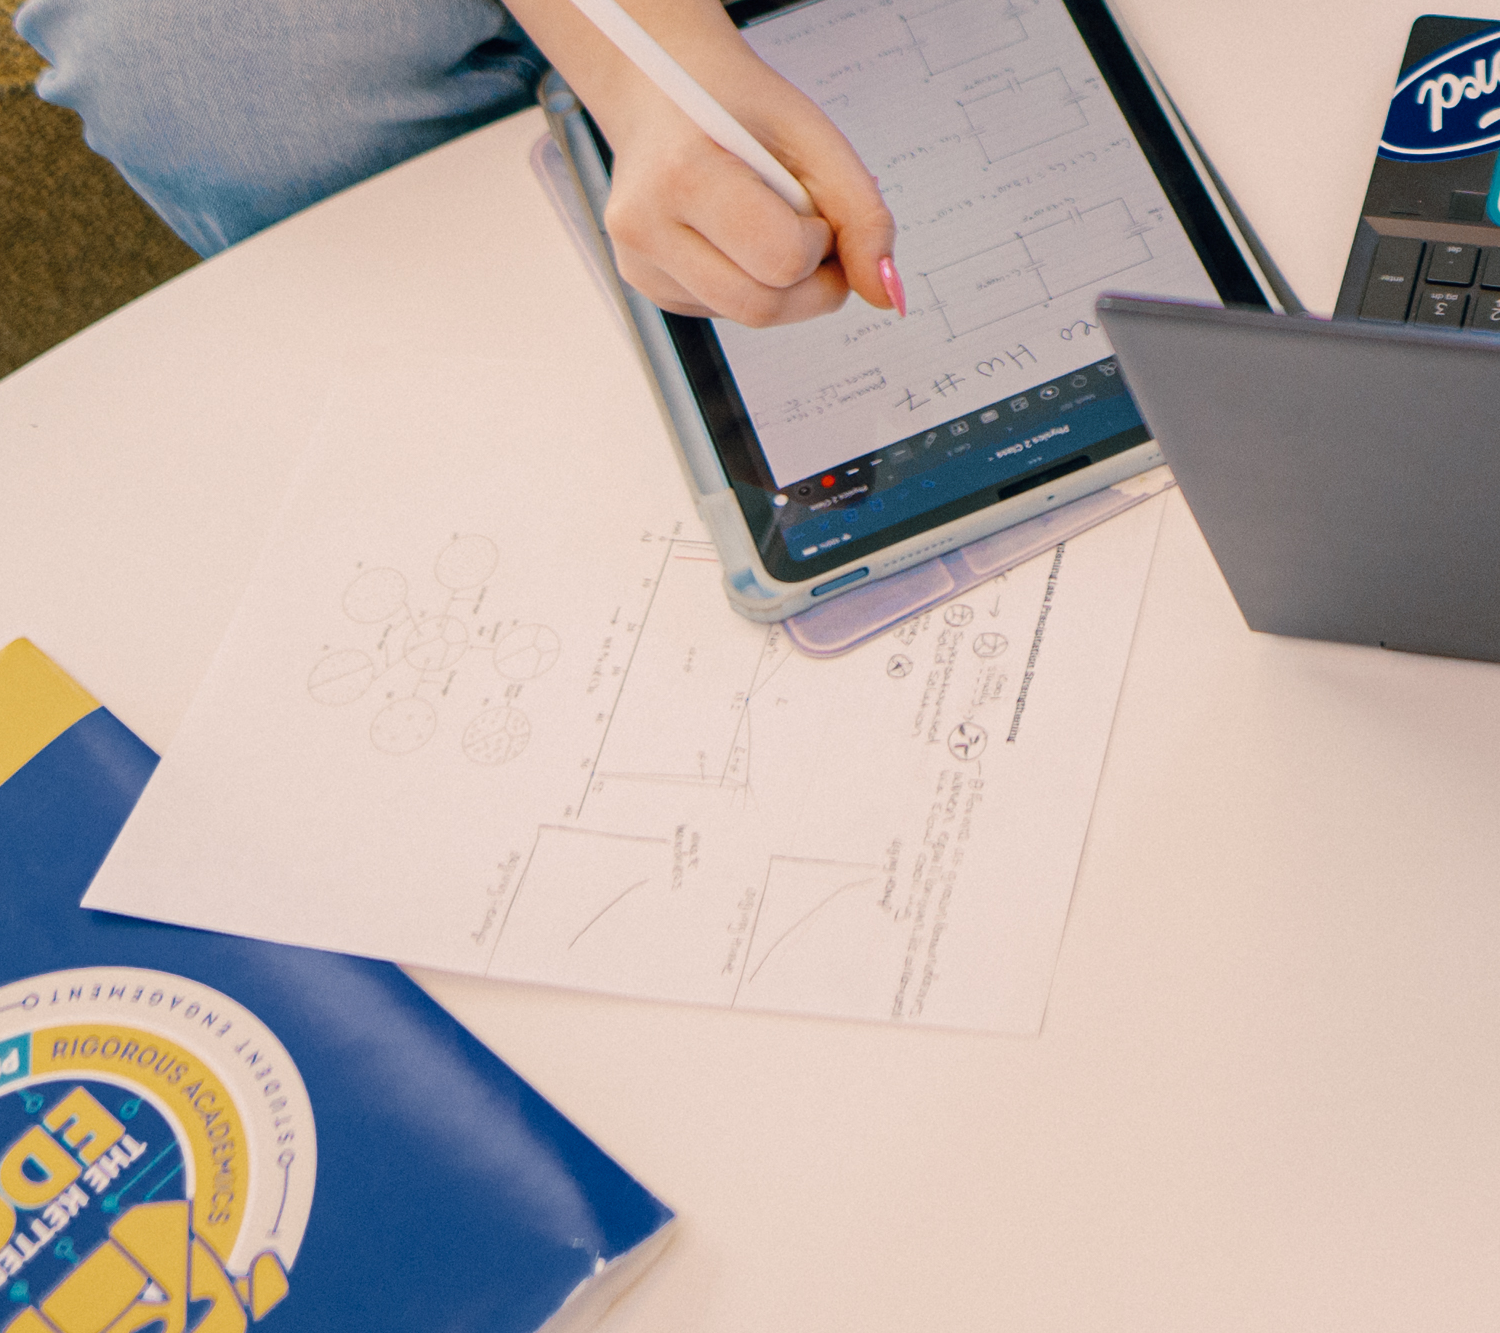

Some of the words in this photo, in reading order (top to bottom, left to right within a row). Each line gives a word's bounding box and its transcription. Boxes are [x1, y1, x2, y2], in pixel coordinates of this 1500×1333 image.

[1433, 301, 1449, 316] 3
[975, 343, 1038, 378] HW
[995, 441, 1024, 460] Class
[1031, 424, 1070, 445] Physics
[1027, 603, 1052, 670] Precipitation
[1006, 670, 1036, 744] Strengthening
[49, 982, 233, 1046] ENGAGEMENT
[233, 1040, 297, 1150] STUDENT
[52, 1035, 189, 1086] RIGOROUS
[183, 1079, 231, 1228] ACADEMICS
[80, 1134, 147, 1197] THE
